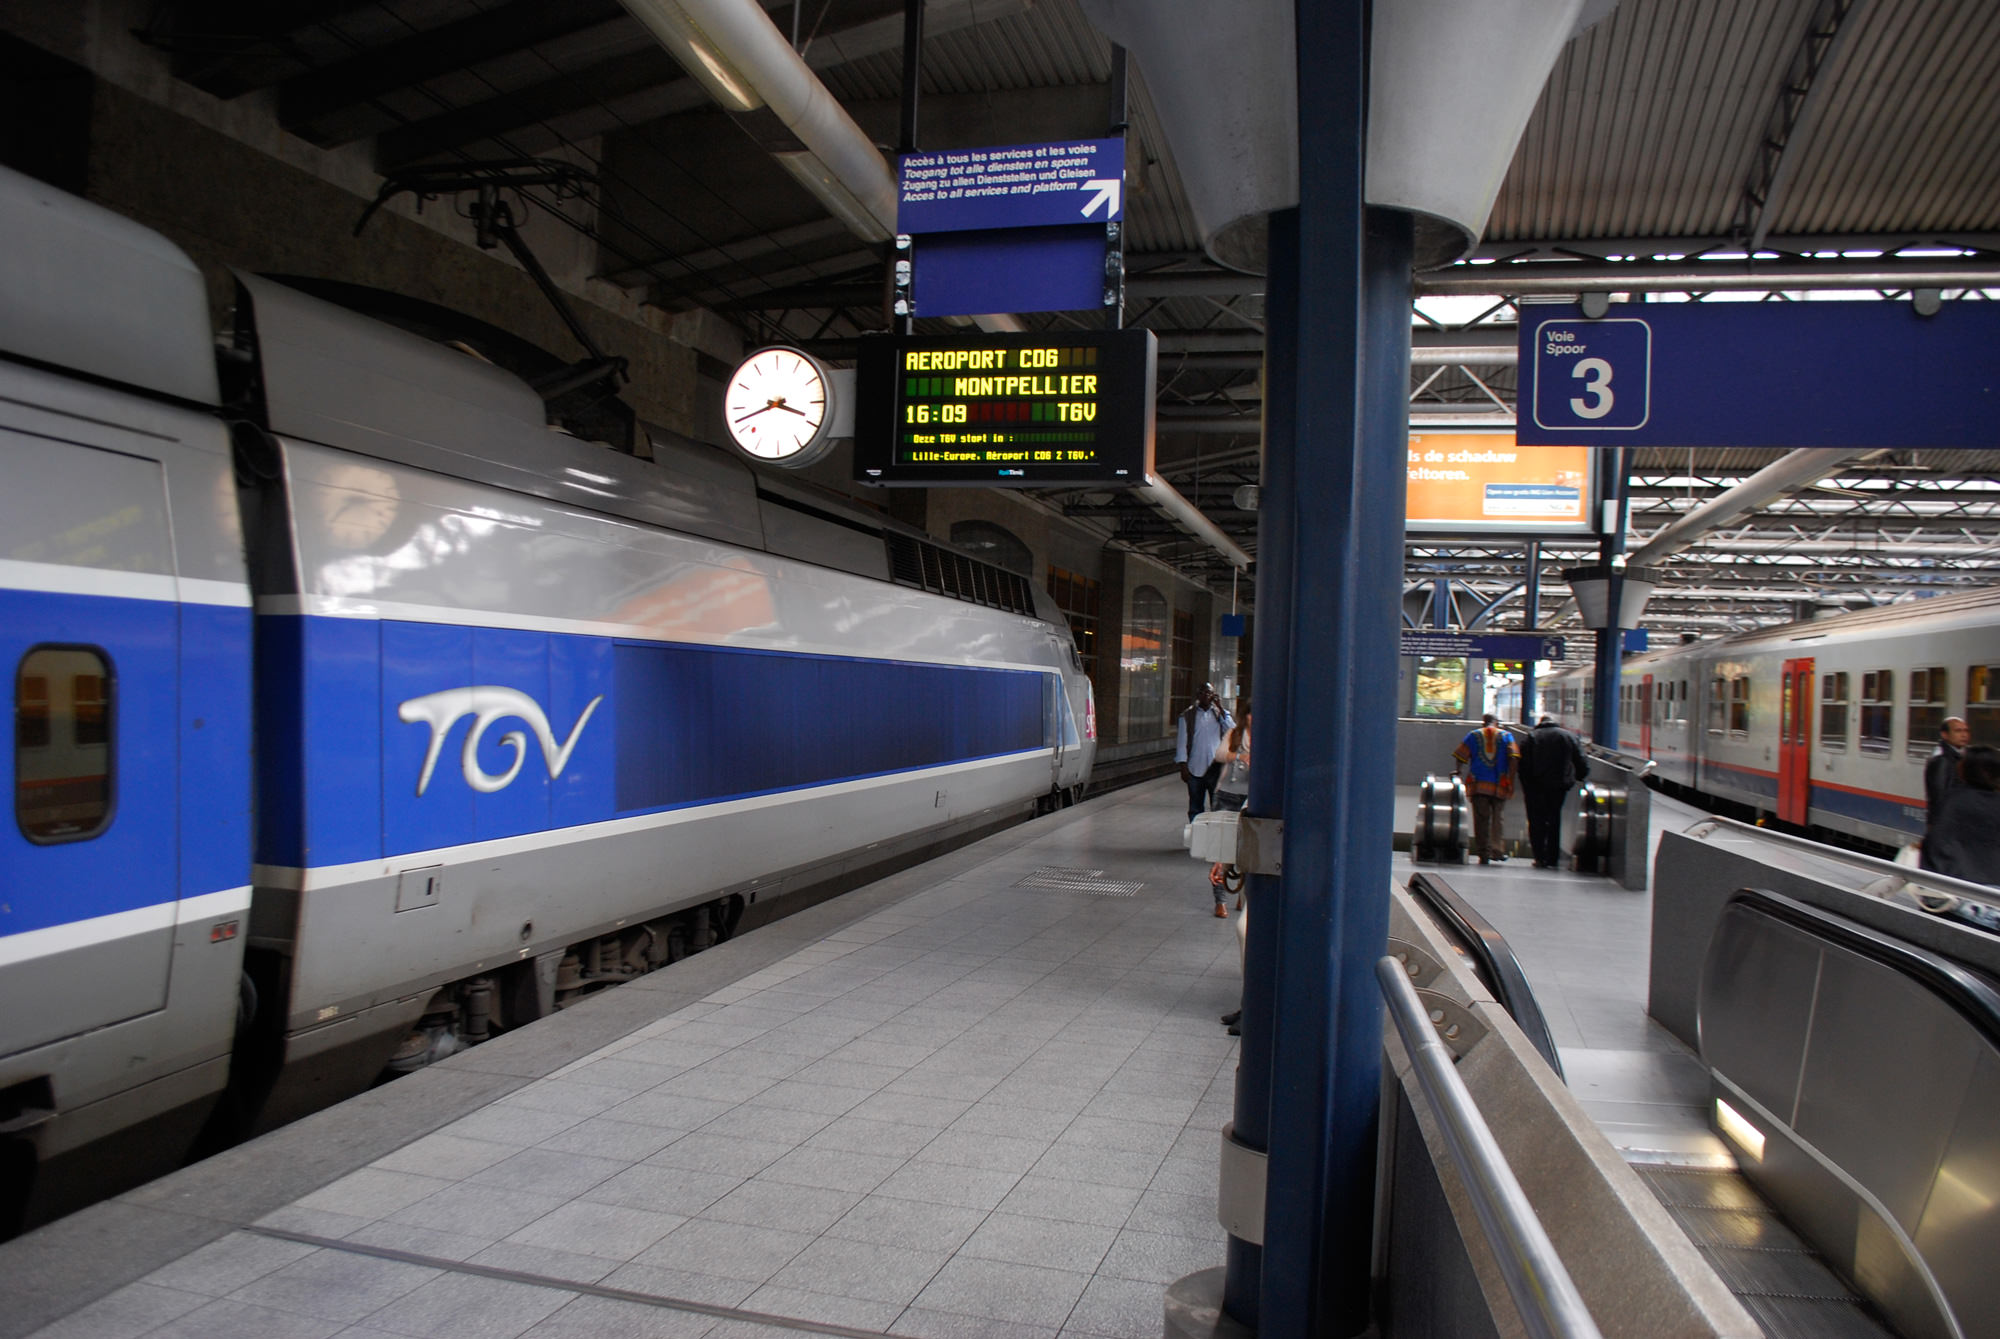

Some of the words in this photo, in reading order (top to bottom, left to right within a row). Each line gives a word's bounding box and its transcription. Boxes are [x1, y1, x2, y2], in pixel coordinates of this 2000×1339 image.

[904, 156, 935, 167] Accès
[937, 154, 944, 165] à
[947, 154, 969, 164] tous
[971, 152, 987, 162] les
[989, 149, 1034, 161] services
[1035, 148, 1047, 157] et
[1049, 147, 1065, 156] les
[1068, 144, 1097, 154] voies
[905, 168, 948, 179] Toegang
[950, 166, 964, 175] tot
[966, 164, 985, 174] alle
[987, 161, 1032, 173] diensten
[1034, 160, 1049, 169] en
[1051, 158, 1088, 169] sporen
[903, 180, 937, 192] Zugang
[939, 179, 951, 188] zu
[952, 177, 975, 187] allen
[977, 172, 1037, 185] Dienststellen
[1039, 170, 1057, 180] und
[1059, 168, 1096, 179] Gleisen
[904, 192, 935, 202] Acces
[937, 190, 948, 200] to
[949, 188, 963, 198] all
[965, 186, 1009, 197] services
[1010, 184, 1031, 194] and
[1032, 181, 1077, 195] platform
[1547, 331, 1575, 342] Voie
[906, 350, 1007, 371] AEROPORT
[1019, 348, 1059, 368] CDG
[1546, 343, 1586, 357] Spoor
[955, 375, 1097, 396] MONTPELLIER
[1570, 357, 1614, 419] 3
[906, 404, 967, 424] 16:09
[1057, 402, 1097, 422] TGV
[913, 434, 935, 444] Deze
[940, 433, 956, 443] TGV
[960, 433, 987, 443] stopt
[993, 433, 1004, 443] in
[986, 450, 1029, 461] Aéroport
[1056, 450, 1063, 460] 2
[1424, 449, 1444, 462] de
[1447, 449, 1517, 463] schaduw
[398, 684, 604, 798] TGV
